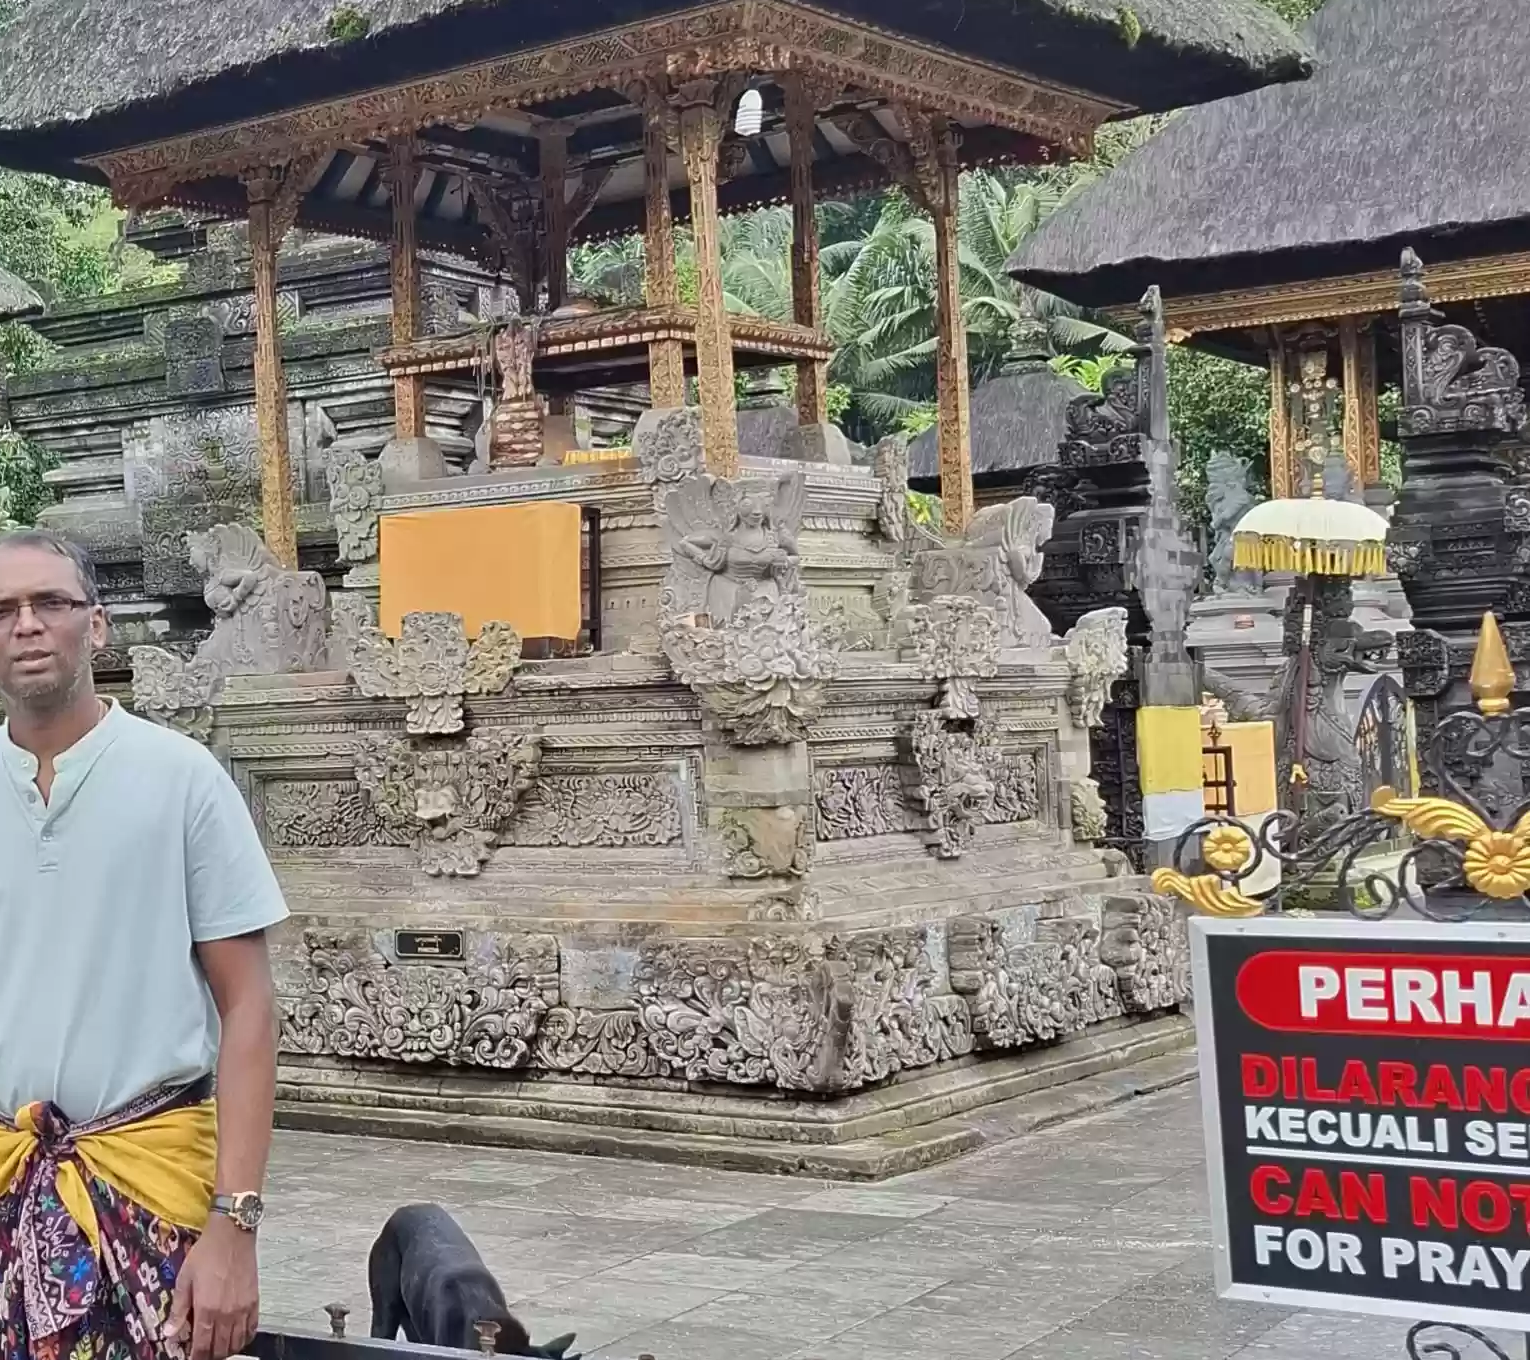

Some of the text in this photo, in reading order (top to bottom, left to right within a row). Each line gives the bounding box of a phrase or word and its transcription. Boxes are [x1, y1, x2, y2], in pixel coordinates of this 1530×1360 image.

[1244, 1104, 1530, 1159] KECUALI SE
[1249, 1164, 1389, 1224] CAN
[1254, 1224, 1530, 1291] FOR PRAY
